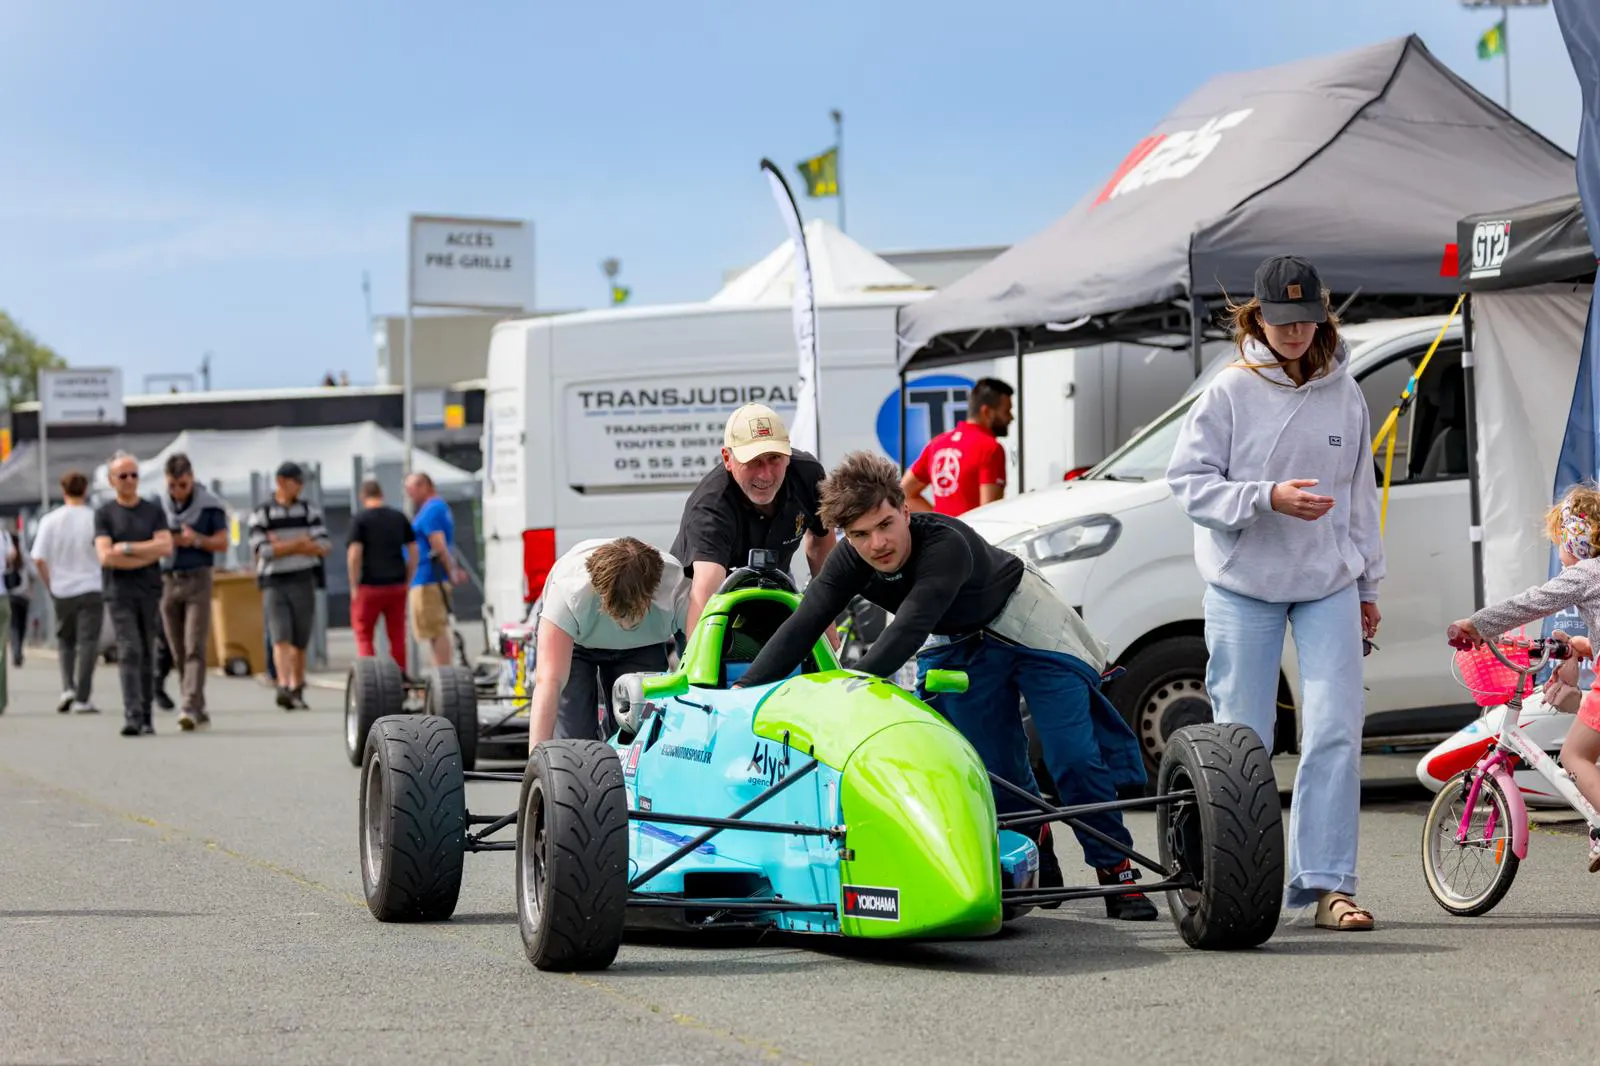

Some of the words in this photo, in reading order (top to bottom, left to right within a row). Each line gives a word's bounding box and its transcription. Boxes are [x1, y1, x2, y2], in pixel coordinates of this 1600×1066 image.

[578, 386, 797, 408] TRANSJUDIPAL
[604, 422, 701, 435] TRANSPORT
[615, 438, 676, 450] TOUTES
[614, 458, 640, 471] 05
[648, 456, 673, 469] 55
[681, 454, 706, 467] 24
[747, 776, 771, 787] agenc
[857, 893, 897, 912] YOKOHAMA
